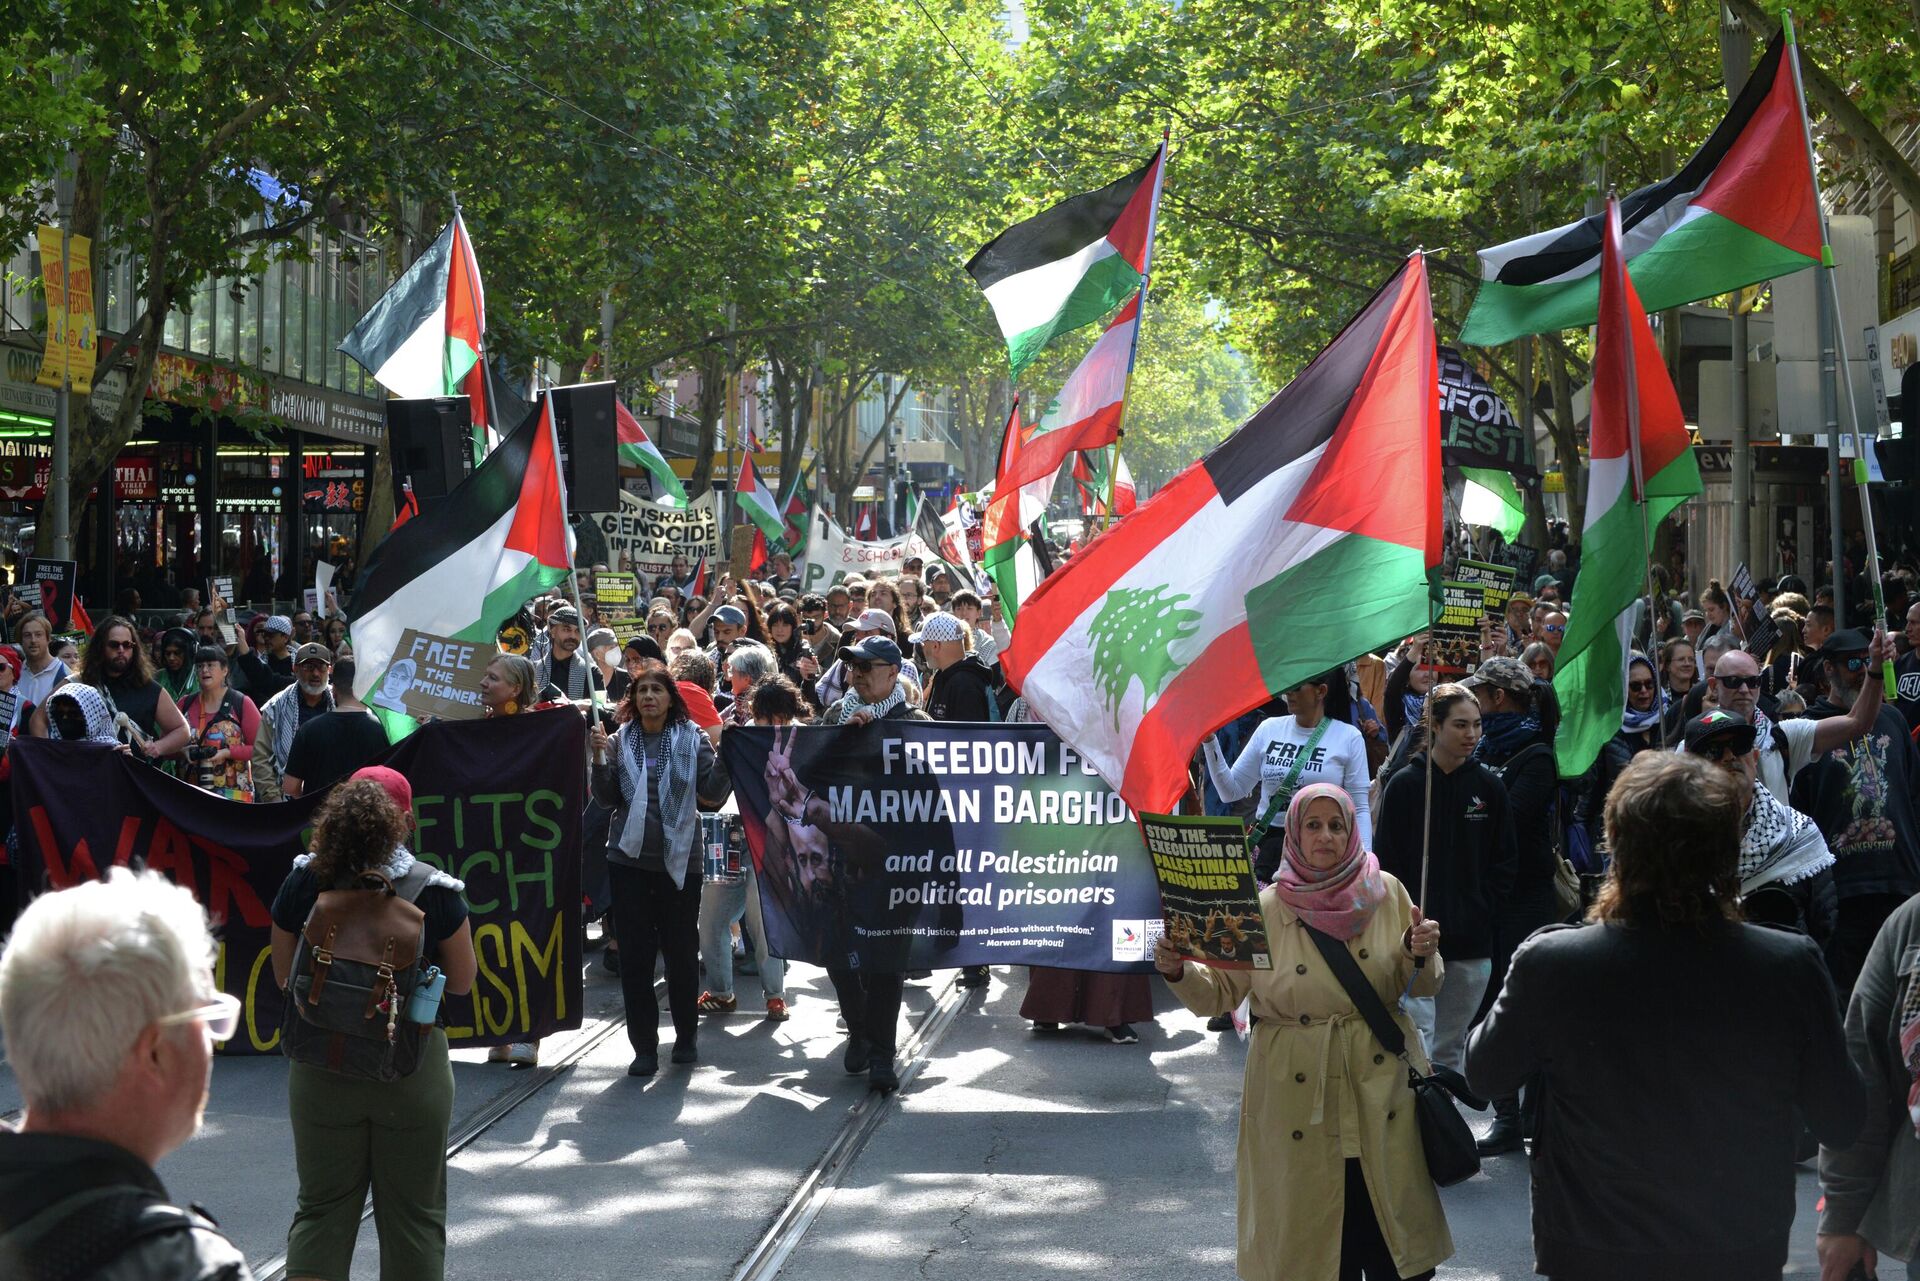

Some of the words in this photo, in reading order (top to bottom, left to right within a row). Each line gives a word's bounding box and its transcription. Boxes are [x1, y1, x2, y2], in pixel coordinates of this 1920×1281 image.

[114, 468, 153, 482] THAI
[620, 500, 638, 514] OP
[641, 506, 712, 523] ISRAEL'S
[601, 515, 716, 542] GENOCIDE
[610, 537, 628, 550] IN
[630, 540, 716, 558] PALESTINE
[1460, 566, 1480, 576] STOP
[1480, 569, 1495, 580] THE
[1451, 589, 1465, 598] THE
[1501, 582, 1510, 591] OF
[1444, 599, 1472, 607] UTION
[1473, 600, 1482, 608] OF
[1445, 606, 1483, 617] ESTINIAN
[1440, 615, 1474, 626] SONERS
[410, 637, 475, 670] FREE
[425, 668, 454, 683] THE
[411, 680, 482, 705] PRISONERS
[883, 738, 1046, 776] FREEDOM
[1060, 742, 1100, 776] FO
[1266, 740, 1326, 763] FRE
[1266, 755, 1322, 773] ARGUTI
[828, 786, 980, 824] MARWAN
[994, 785, 1138, 826] BARGHO
[412, 789, 564, 852] FITS
[1145, 824, 1178, 838] STOP
[1180, 828, 1208, 843] THE
[1148, 838, 1223, 858] EXECUTION
[1226, 844, 1243, 858] OF
[30, 805, 272, 928] WAR
[885, 850, 932, 873] and
[939, 850, 971, 873] all
[978, 851, 1118, 874] Palestinian
[1153, 853, 1249, 874] PALESTINIAN
[1158, 868, 1239, 890] PRISONERS
[889, 881, 992, 910] political
[998, 882, 1115, 910] prisoners
[893, 926, 926, 935] without
[927, 927, 958, 937] justice,
[990, 926, 1019, 936] justice
[1020, 924, 1054, 933] without
[1056, 924, 1094, 935] freedom."
[1023, 938, 1064, 947] Barghouti
